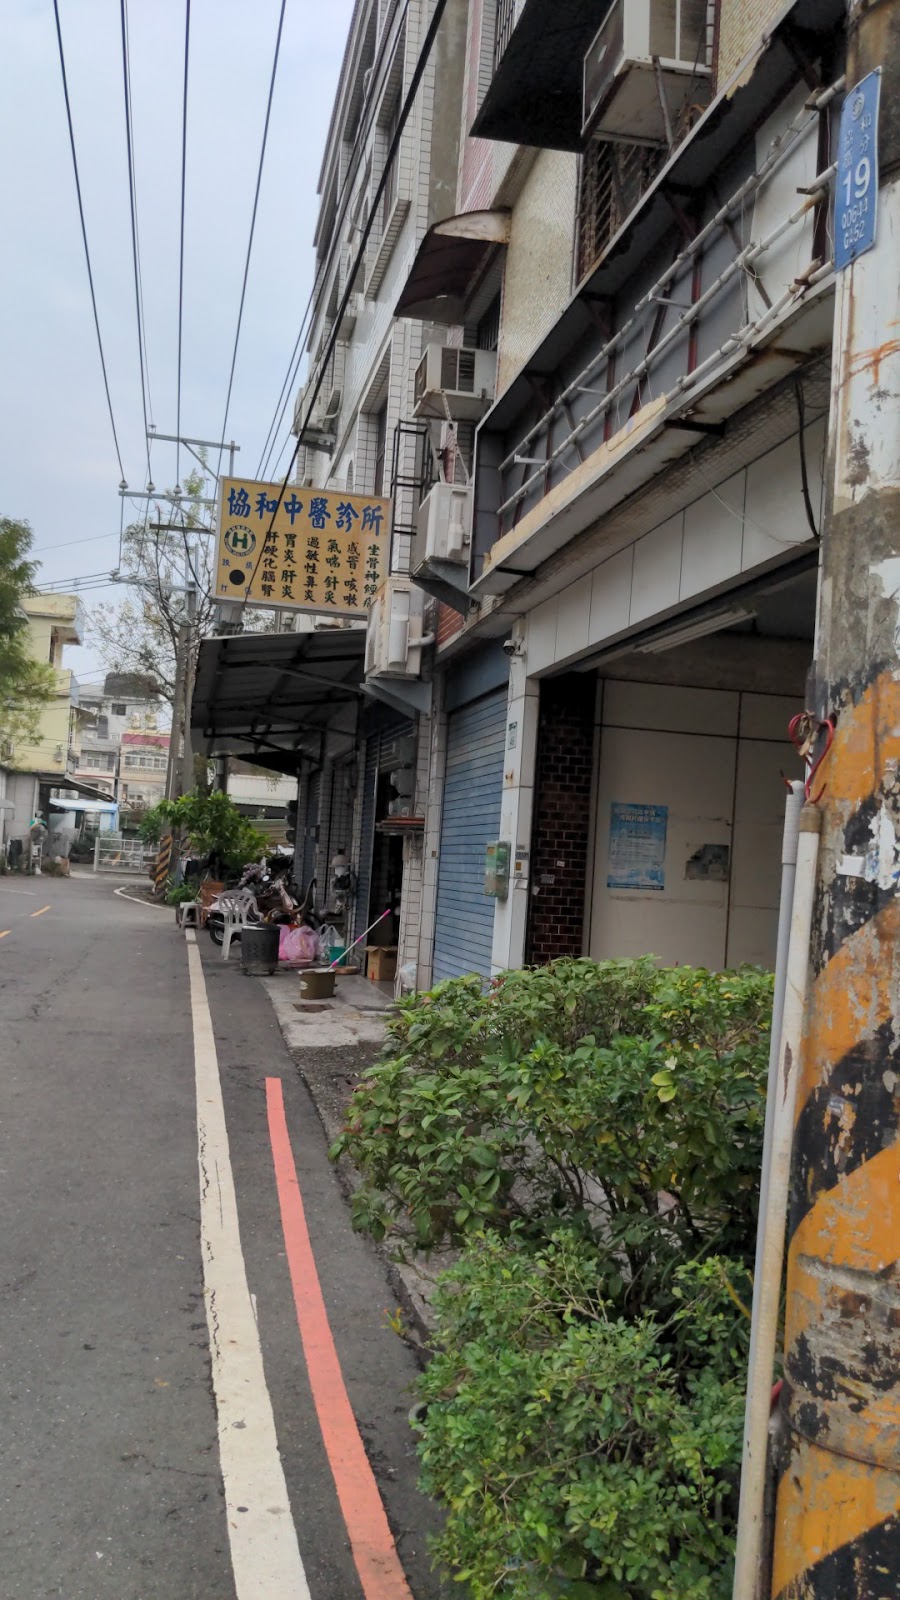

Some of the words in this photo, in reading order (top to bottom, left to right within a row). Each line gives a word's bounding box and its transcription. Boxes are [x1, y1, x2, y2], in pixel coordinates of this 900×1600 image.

[843, 157, 871, 206] 19
[227, 487, 384, 537] 協和中醫診所
[303, 536, 320, 603] 過敏性鼻炎
